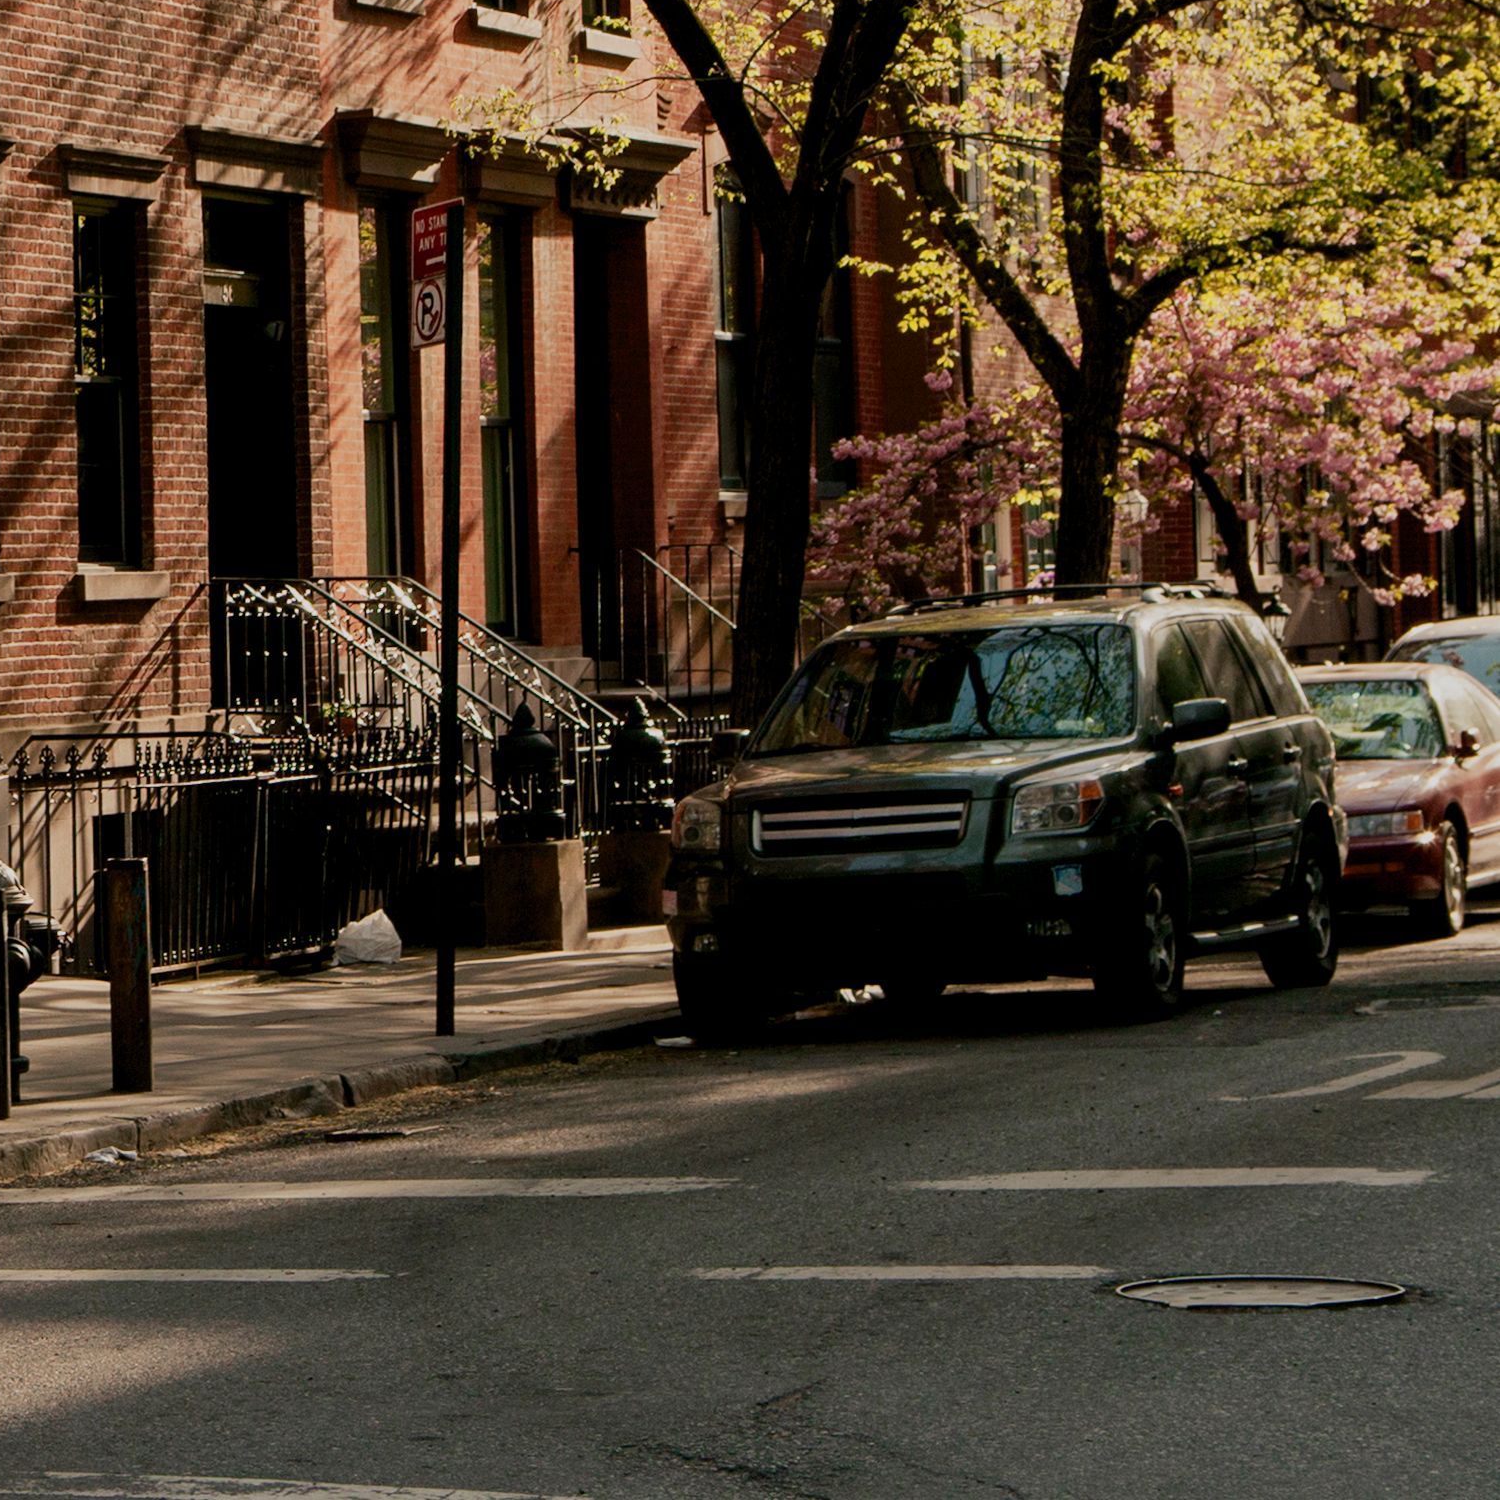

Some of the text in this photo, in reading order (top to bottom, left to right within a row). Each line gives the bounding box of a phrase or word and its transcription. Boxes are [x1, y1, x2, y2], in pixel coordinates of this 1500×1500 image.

[415, 213, 447, 235] NO STAN
[419, 234, 436, 252] ANY
